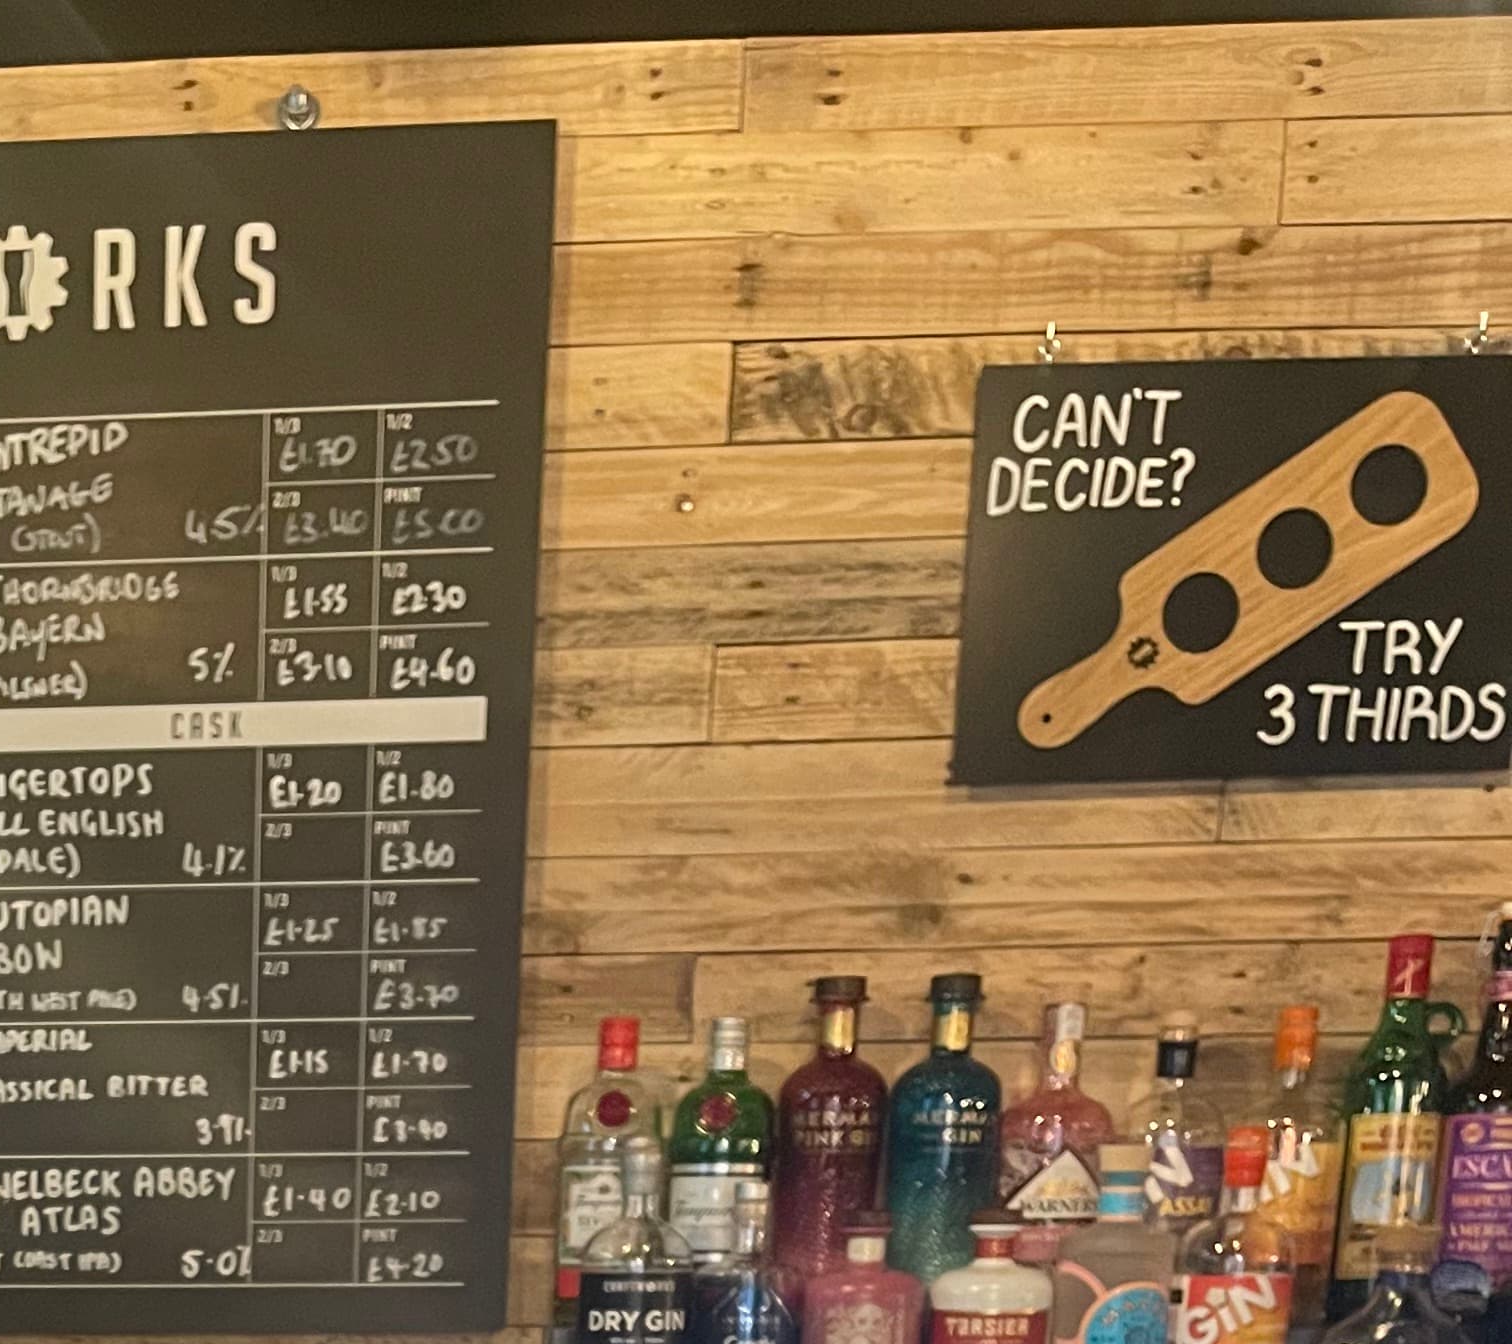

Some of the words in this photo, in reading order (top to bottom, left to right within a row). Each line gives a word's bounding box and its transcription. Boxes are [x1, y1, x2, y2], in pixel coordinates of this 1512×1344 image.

[1013, 387, 1181, 452] CAN'T
[988, 448, 1196, 516] DECIDE?
[188, 642, 235, 682] 5%
[1339, 618, 1463, 675] TRY
[171, 713, 243, 740] CASK
[1256, 684, 1295, 745] 3
[1308, 682, 1507, 743] THIRDS
[39, 809, 164, 837] ENGLISH
[107, 1075, 208, 1097] BITTER
[134, 1166, 235, 1200] ABBEY
[21, 1204, 121, 1237] ATLAS
[589, 1310, 640, 1332] DRY
[645, 1310, 686, 1331] GIN
